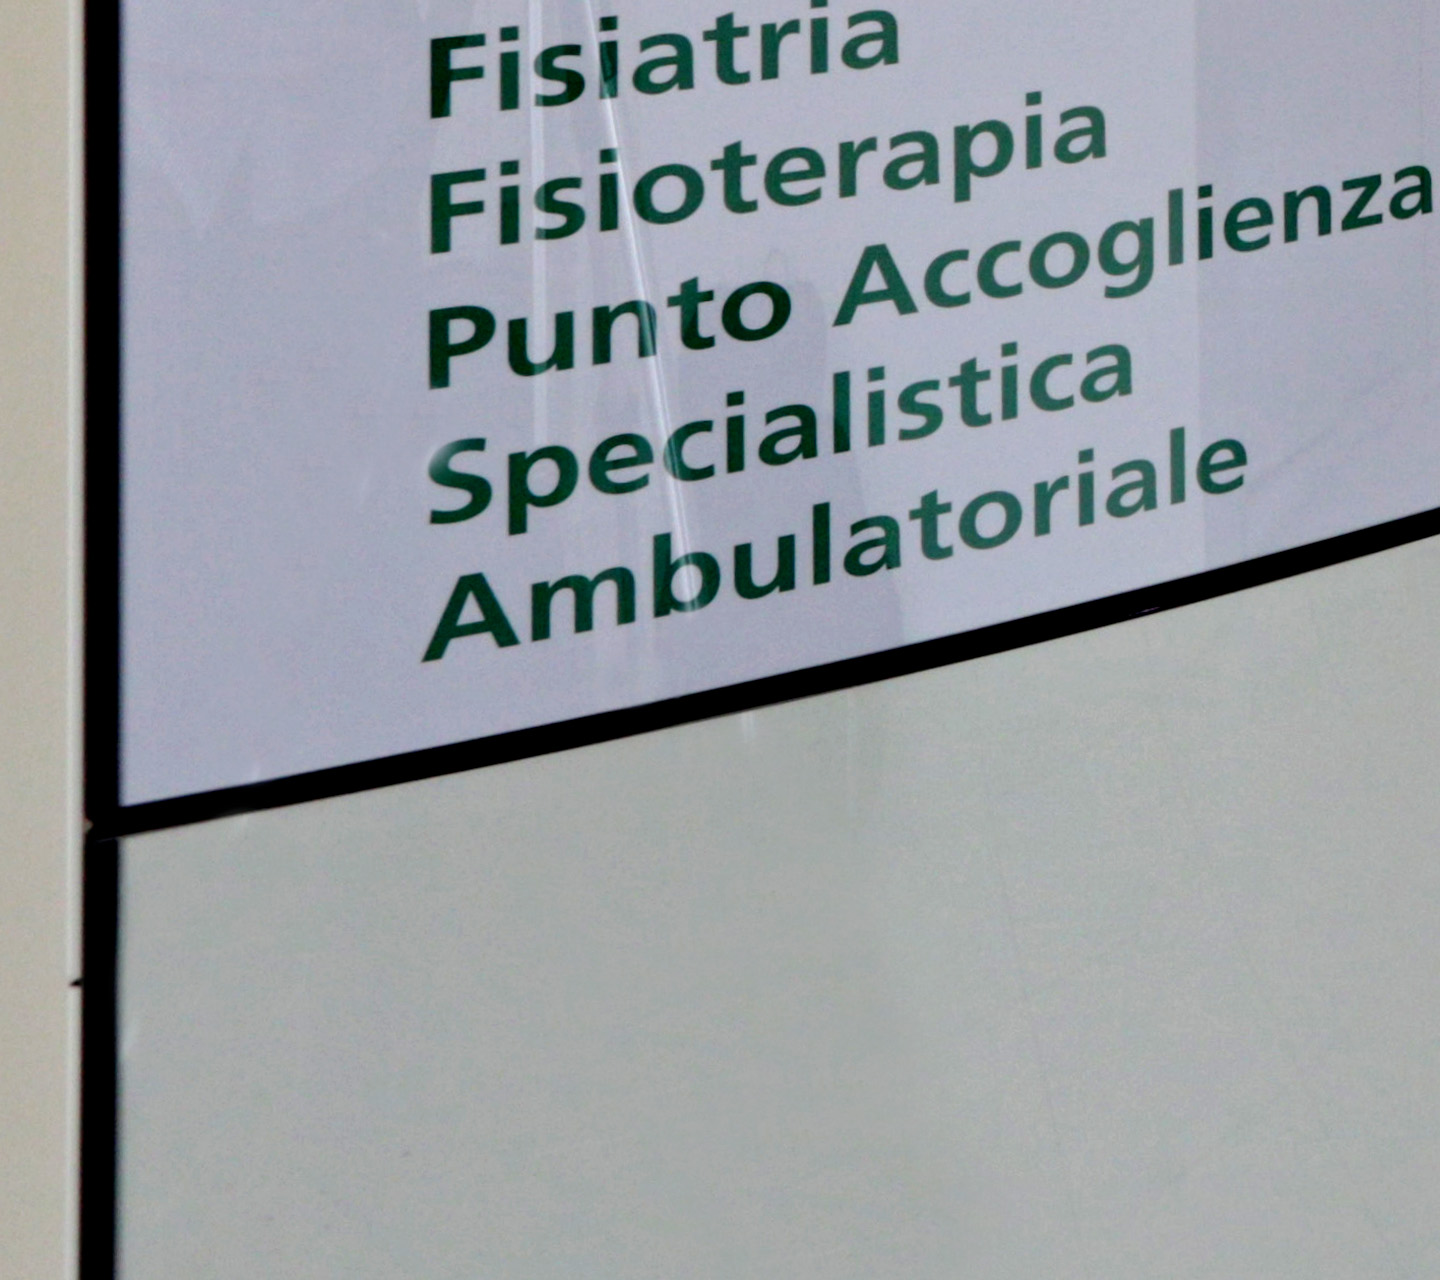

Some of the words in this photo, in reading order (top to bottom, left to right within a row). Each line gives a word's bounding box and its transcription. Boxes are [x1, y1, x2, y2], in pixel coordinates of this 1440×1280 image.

[427, 276, 794, 390] Punto
[834, 163, 1435, 327] Accoglienza
[428, 91, 1110, 255] Fisioterapia
[427, 333, 1134, 538] Specialistica
[422, 425, 1250, 664] Ambulatoriale
